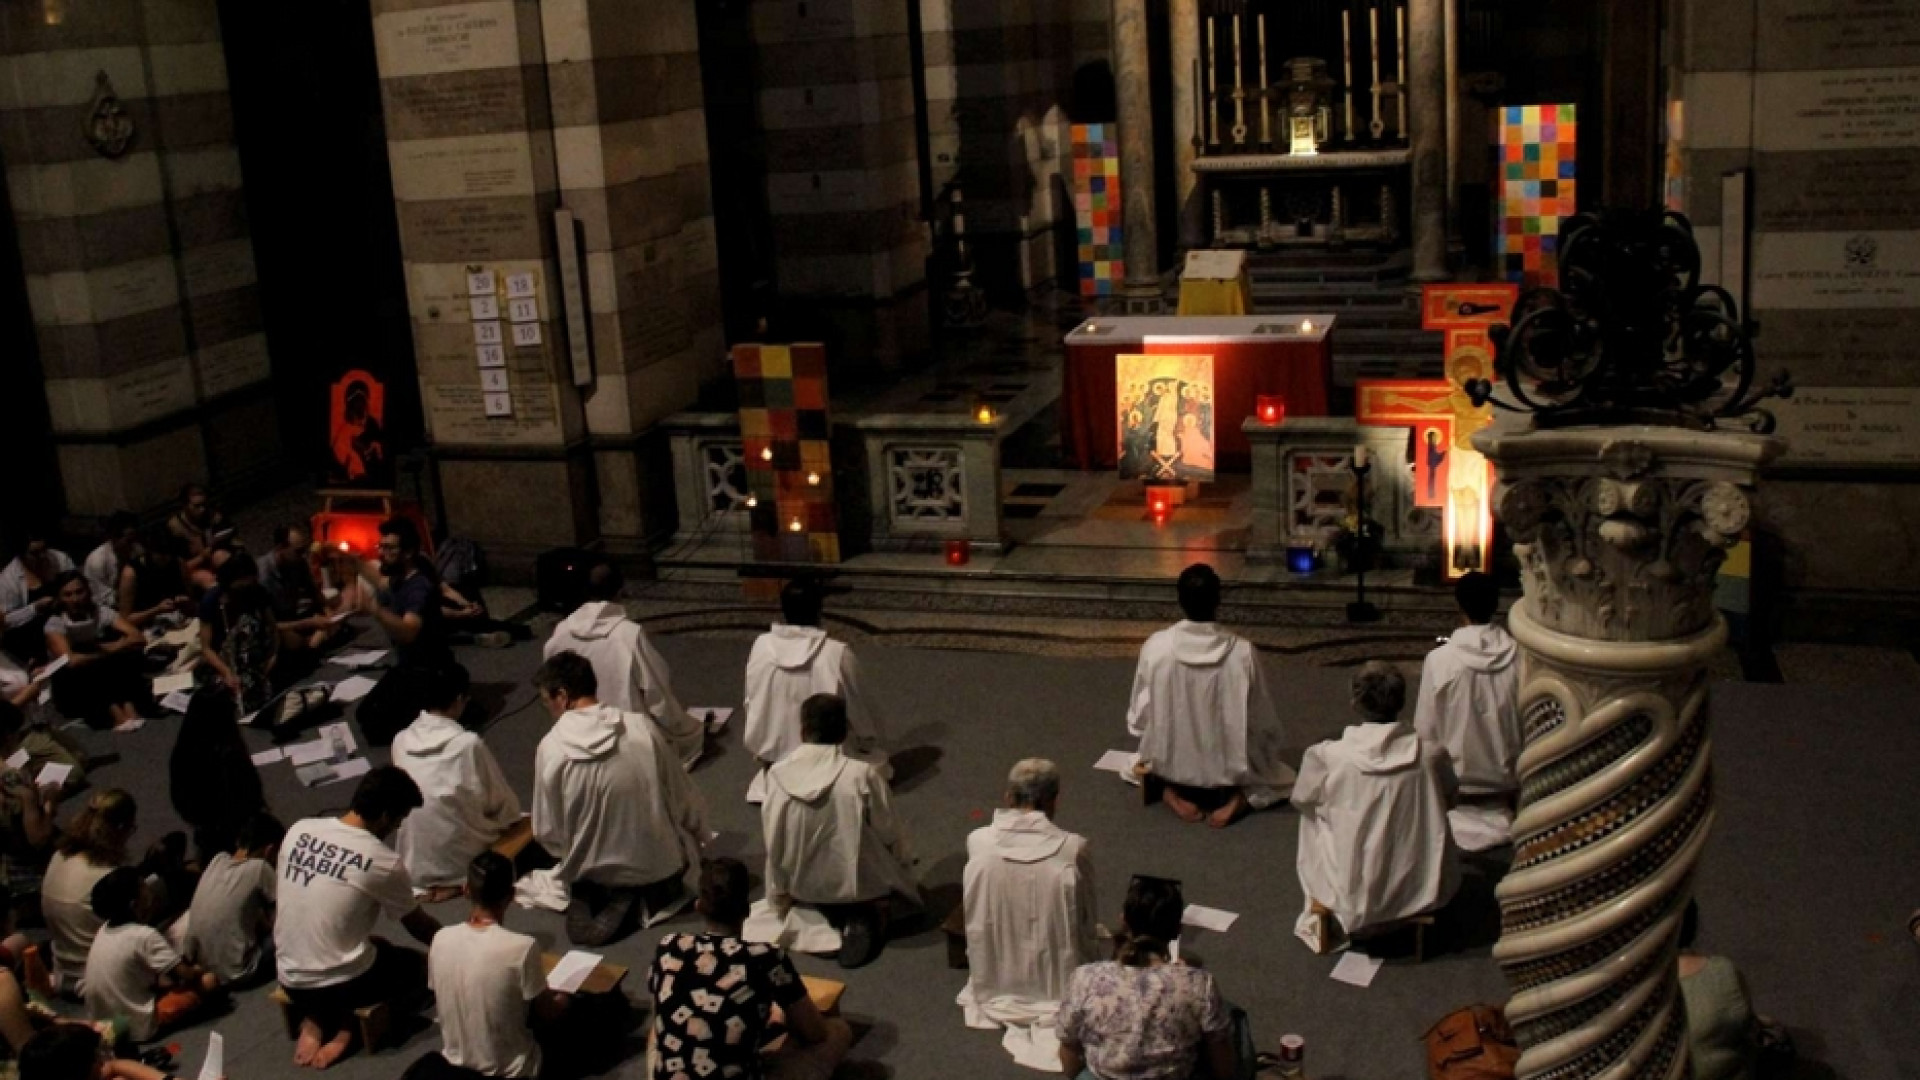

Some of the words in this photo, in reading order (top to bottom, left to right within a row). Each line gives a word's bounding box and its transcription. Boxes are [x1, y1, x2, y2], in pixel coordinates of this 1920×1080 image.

[475, 277, 490, 291] 20
[480, 301, 489, 314] 2
[516, 304, 531, 317] 11
[480, 326, 495, 340] 21
[520, 327, 535, 341] 10
[484, 348, 499, 363] 16
[491, 374, 499, 386] 4
[495, 397, 503, 411] 6
[296, 832, 374, 873] SUSTAI
[289, 848, 349, 881] NABIL
[284, 863, 316, 887] ITY
